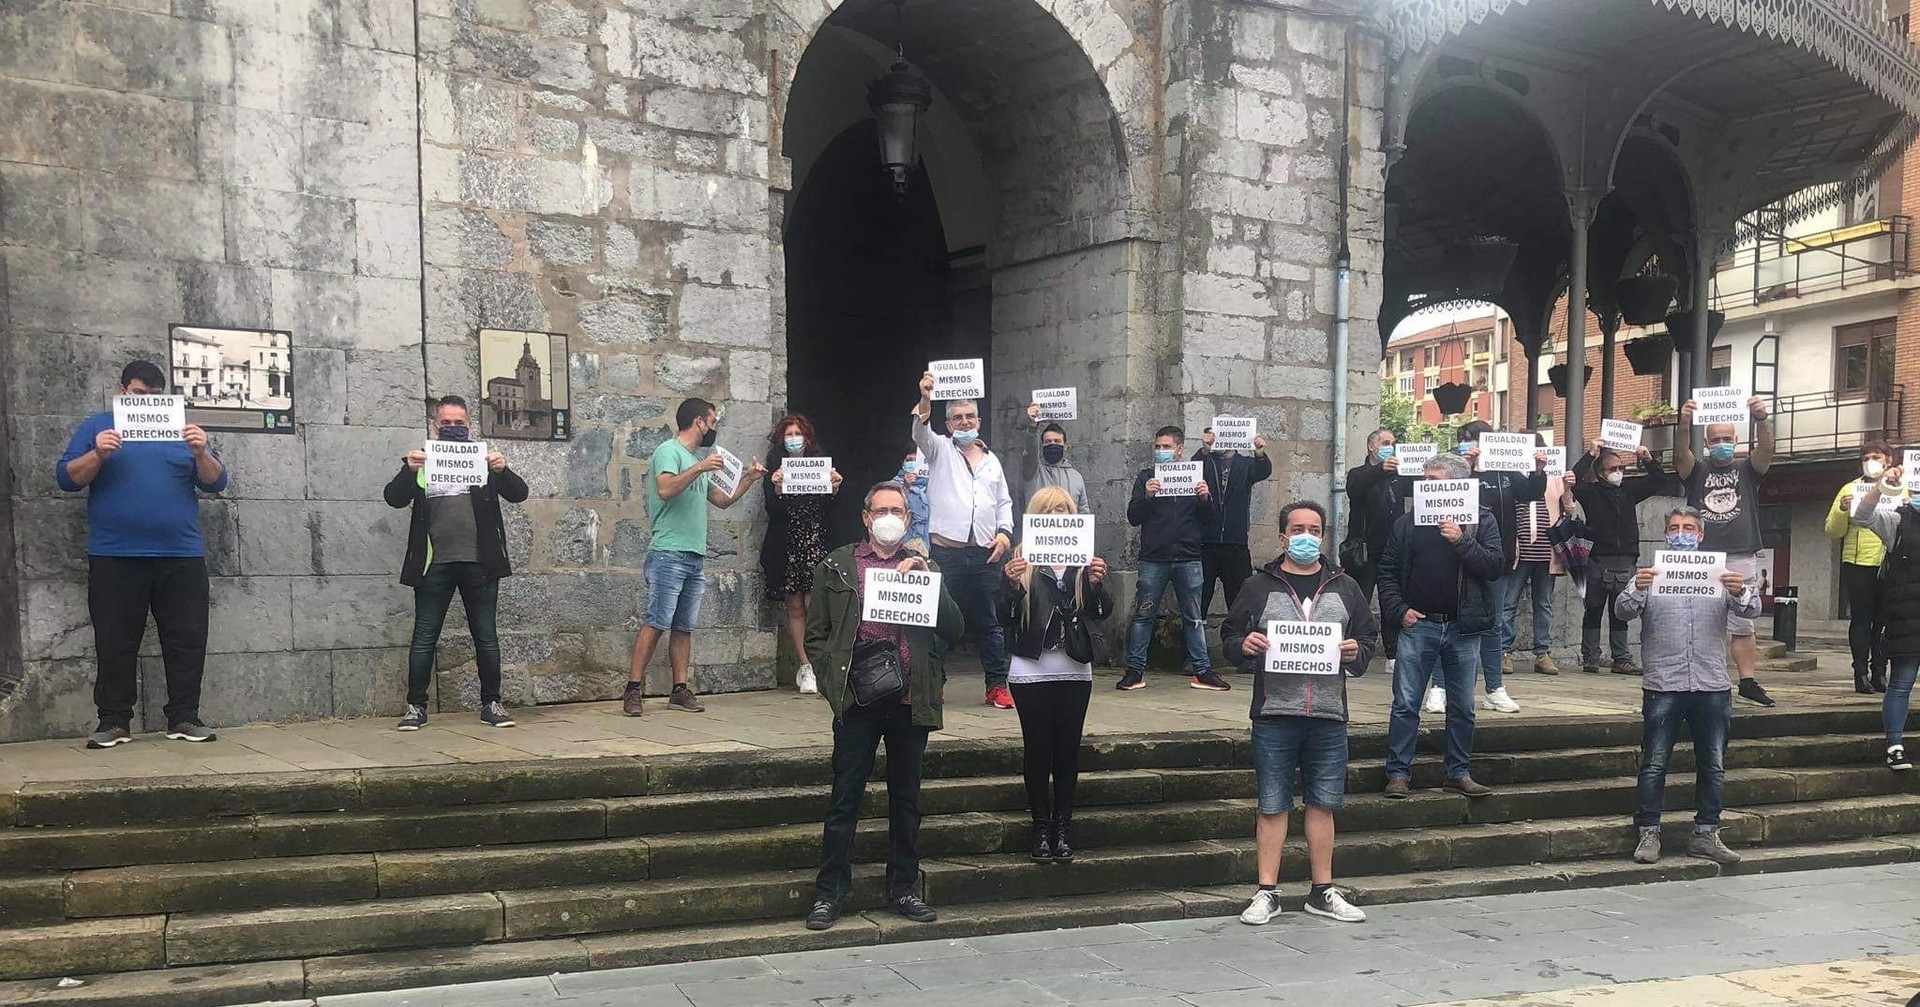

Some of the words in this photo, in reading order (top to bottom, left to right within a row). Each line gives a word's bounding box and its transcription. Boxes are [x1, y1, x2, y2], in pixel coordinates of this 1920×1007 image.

[934, 362, 976, 371] IGUALDAD
[938, 375, 972, 384] MISMOS
[935, 388, 980, 398] DERECHOS
[1036, 390, 1070, 398] IGUALDAD
[1698, 388, 1742, 398] IGUALDAD
[120, 397, 174, 407] IGUALDAD
[1703, 401, 1737, 410] MISMOS
[127, 413, 170, 423] MISMOS
[1698, 413, 1745, 423] DERECHOS
[122, 429, 180, 439] DERECHOS
[1484, 435, 1528, 444] IGUALDAD
[432, 444, 479, 454] IGUALDAD
[1215, 441, 1252, 449] DERECHOS
[1400, 445, 1432, 453] IGUALDAD
[1489, 448, 1524, 457] MISMOS
[436, 459, 475, 469] MISMOS
[786, 460, 825, 468] IGUALDAD
[1159, 464, 1197, 472] IGUALDAD
[1484, 461, 1531, 470] DERECHOS
[431, 474, 482, 484] DERECHOS
[791, 472, 821, 480] MISMOS
[787, 484, 828, 492] DERECHOS
[1420, 482, 1470, 493] IGUALDAD
[1425, 498, 1465, 508] MISMOS
[1030, 517, 1084, 528] IGUALDAD
[1420, 513, 1472, 524] DERECHOS
[1035, 535, 1078, 546] MISMOS
[1029, 553, 1087, 564] DERECHOS
[1662, 554, 1716, 565] IGUALDAD
[873, 571, 931, 586] IGUALDAD
[1666, 570, 1708, 580] MISMOS
[1658, 585, 1715, 595] DERECHOS
[878, 590, 923, 604] MISMOS
[870, 608, 931, 624] DERECHOS
[1275, 624, 1332, 636] IGUALDAD
[1280, 642, 1325, 654] MISMOS
[1272, 659, 1333, 672] DERECHOS
